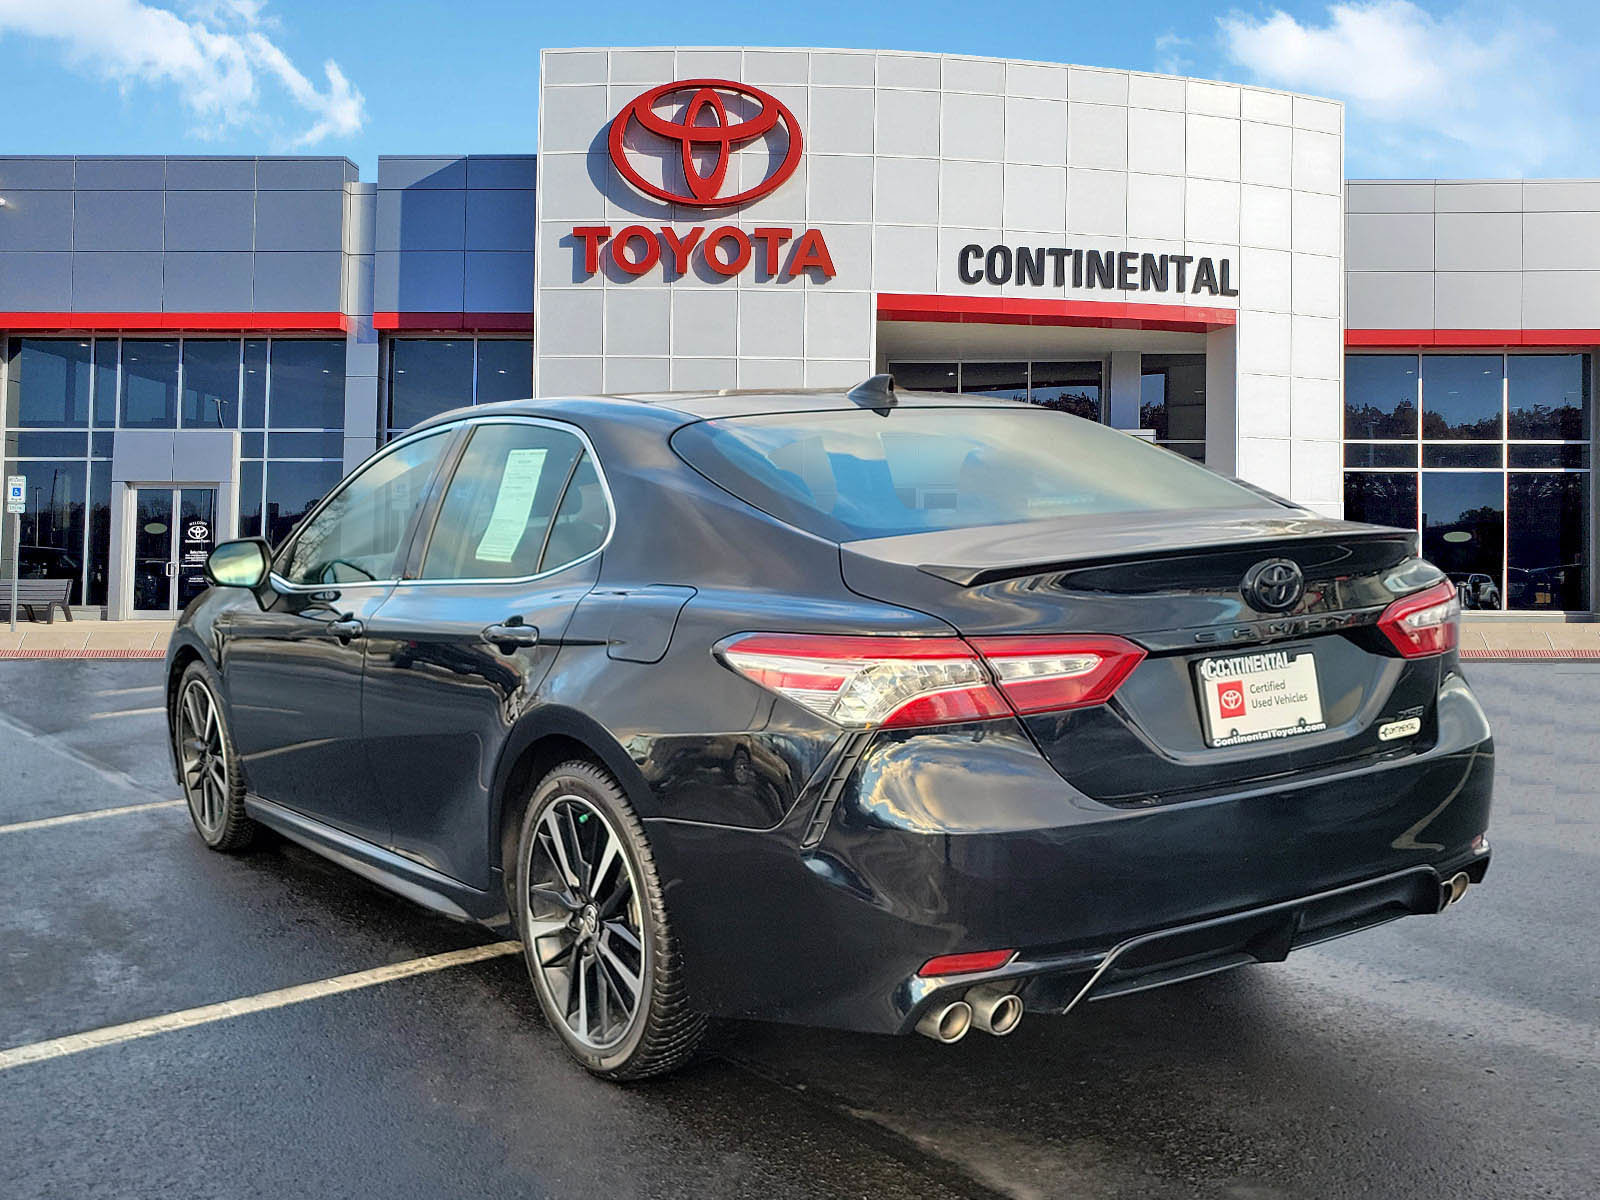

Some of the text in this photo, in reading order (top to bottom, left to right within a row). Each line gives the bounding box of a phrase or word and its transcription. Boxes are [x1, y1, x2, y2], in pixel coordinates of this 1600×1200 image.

[572, 225, 837, 276] TOYOTA
[959, 244, 1239, 296] CONTINENTAL
[1202, 651, 1289, 678] CONTINENTAL
[1250, 680, 1286, 694] Certified
[1252, 693, 1308, 708] Used Vehicles
[1213, 723, 1326, 747] ContinentalToyota.com
